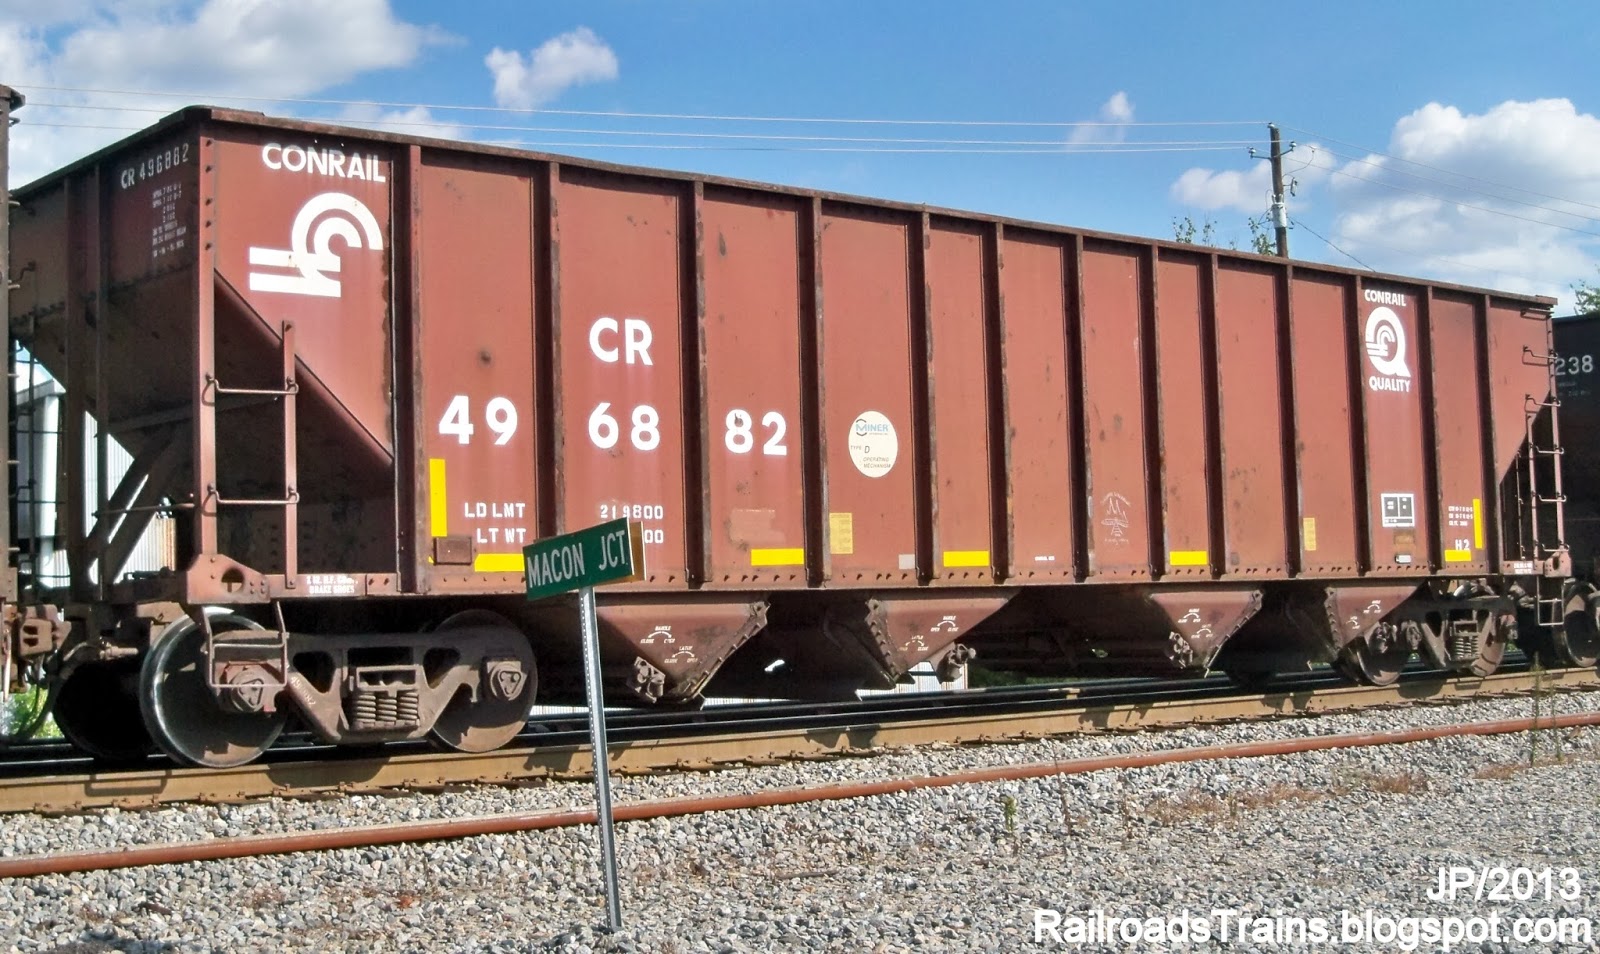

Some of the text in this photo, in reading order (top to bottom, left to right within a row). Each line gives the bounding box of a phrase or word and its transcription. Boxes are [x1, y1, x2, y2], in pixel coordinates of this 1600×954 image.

[121, 143, 189, 189] CR 496882
[262, 142, 386, 182] CONRAIL
[1364, 289, 1406, 307] CONRAIL
[588, 317, 654, 366] CR
[1369, 376, 1411, 393] QUALITY
[855, 423, 889, 432] MINER
[864, 445, 870, 454] D
[464, 502, 487, 518] LD
[492, 502, 526, 519] LMT
[476, 527, 527, 544] LT WT
[526, 529, 627, 588] MACON JCT
